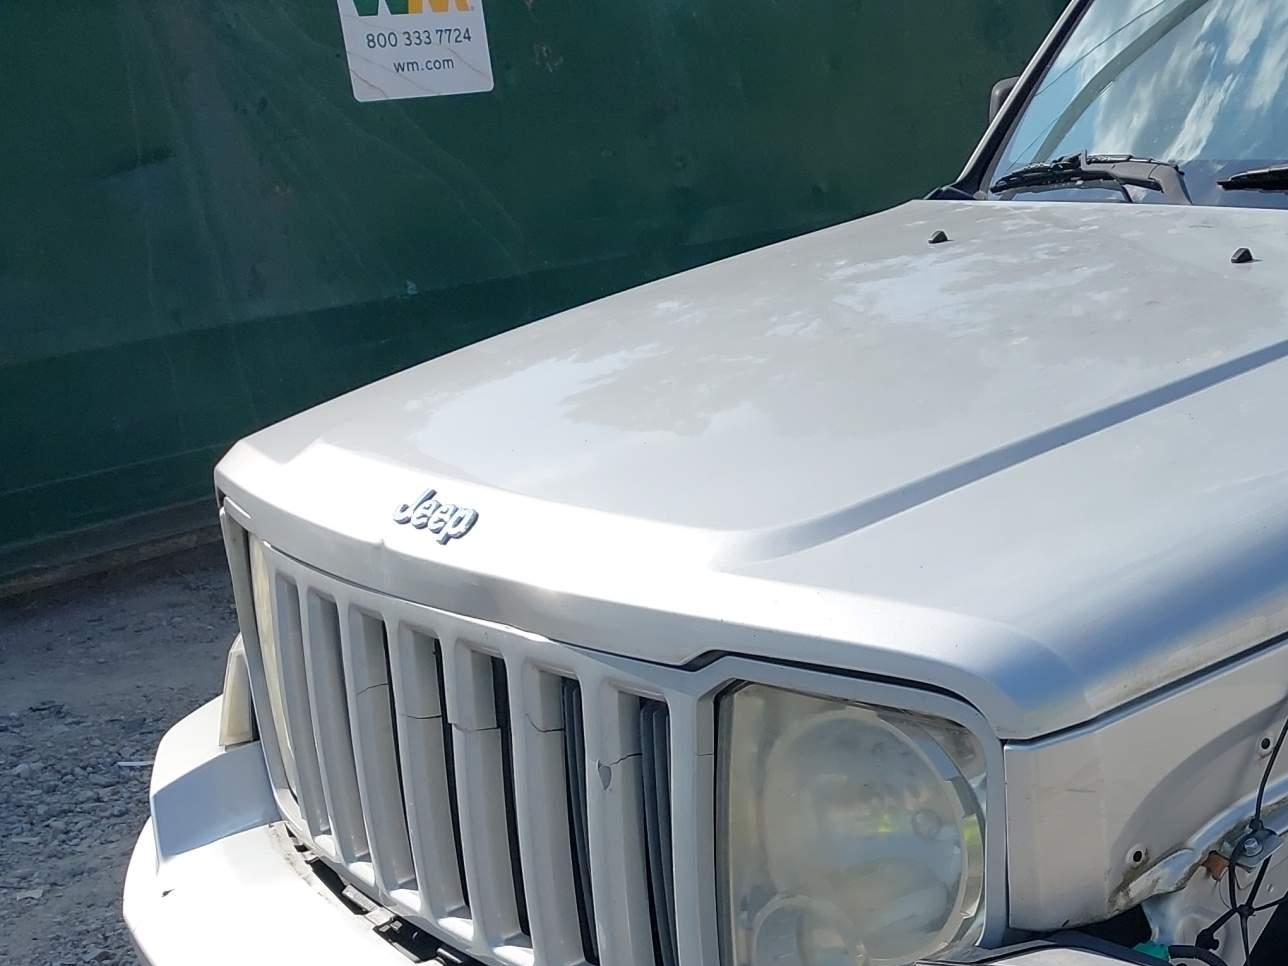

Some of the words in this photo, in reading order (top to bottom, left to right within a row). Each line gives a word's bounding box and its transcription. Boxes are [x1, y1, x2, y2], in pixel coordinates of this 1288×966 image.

[366, 32, 398, 49] 800
[402, 30, 432, 47] 333
[435, 27, 472, 44] 7724
[393, 58, 455, 73] wm.com
[393, 488, 480, 546] Jeep
